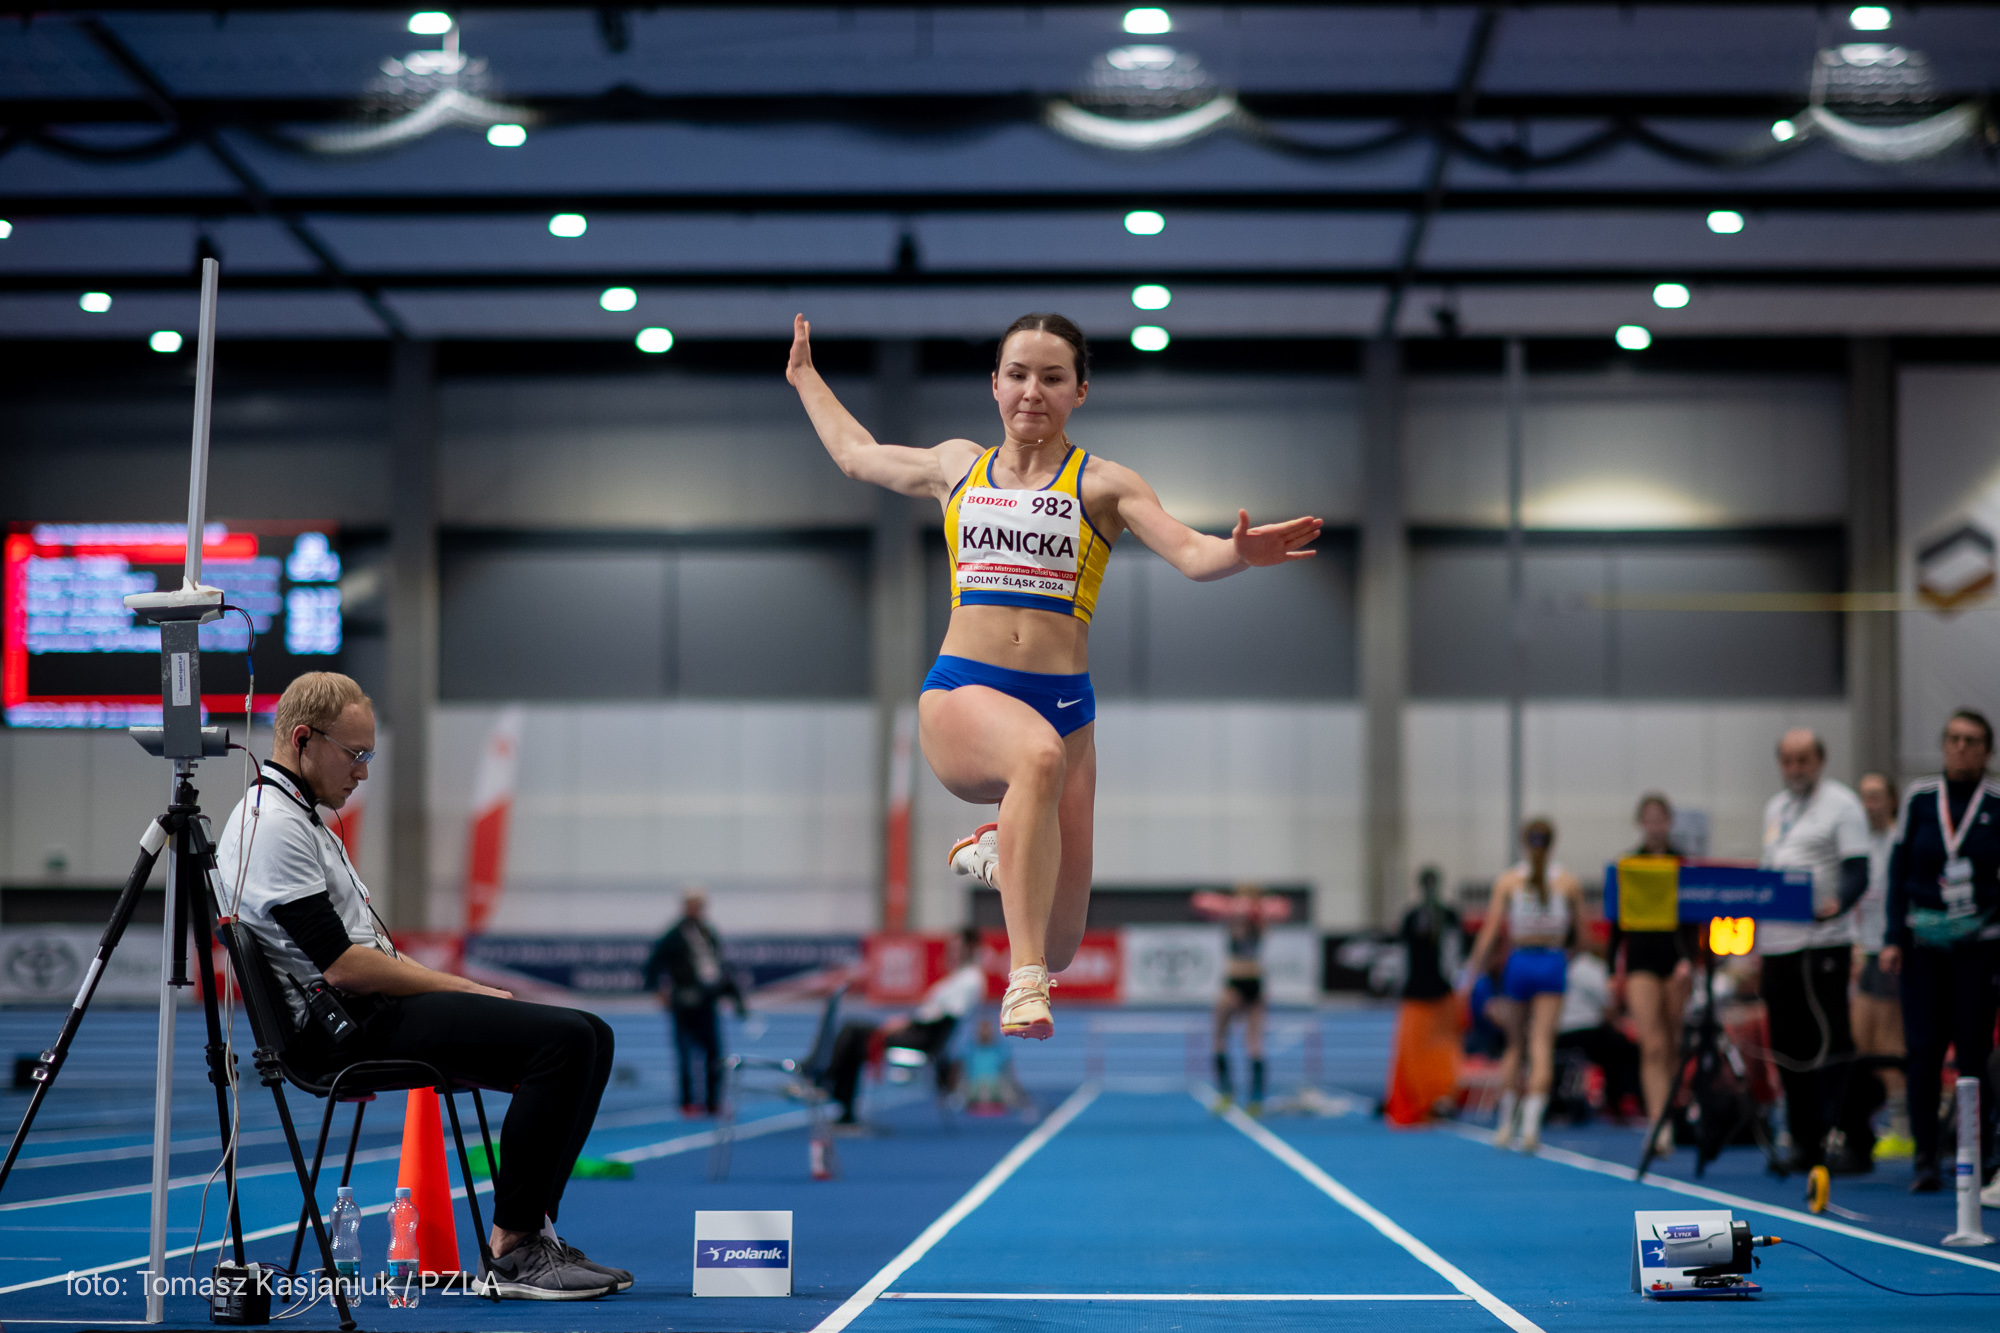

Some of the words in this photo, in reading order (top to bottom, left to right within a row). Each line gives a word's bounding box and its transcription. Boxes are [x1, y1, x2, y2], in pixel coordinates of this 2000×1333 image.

[967, 496, 1017, 508] BODZIO
[1031, 497, 1073, 520] 982
[962, 526, 1074, 558] KANICKA
[995, 566, 1030, 574] Mistrzostwa
[966, 575, 1001, 585] DOLNY
[1002, 575, 1036, 589] ŚLĄSK
[1038, 580, 1064, 591] 2024
[723, 1247, 783, 1262] polanik
